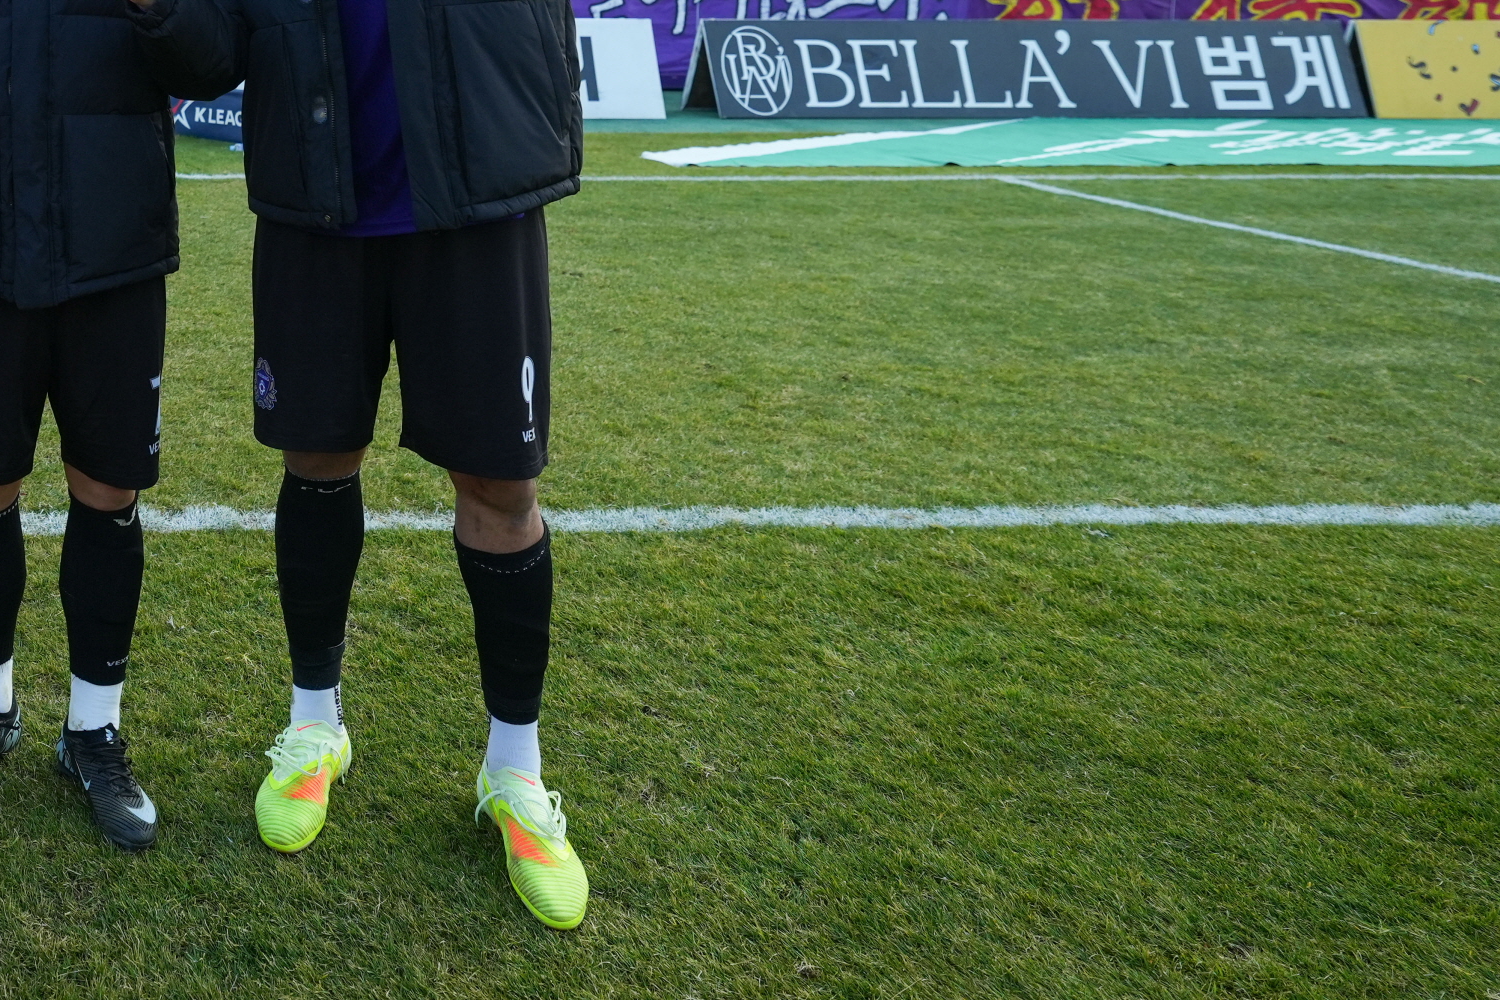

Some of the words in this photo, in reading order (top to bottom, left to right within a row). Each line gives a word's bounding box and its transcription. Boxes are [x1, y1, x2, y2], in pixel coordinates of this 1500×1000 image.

[1194, 34, 1351, 110] 범계
[194, 106, 206, 123] K
[521, 356, 535, 423] 9
